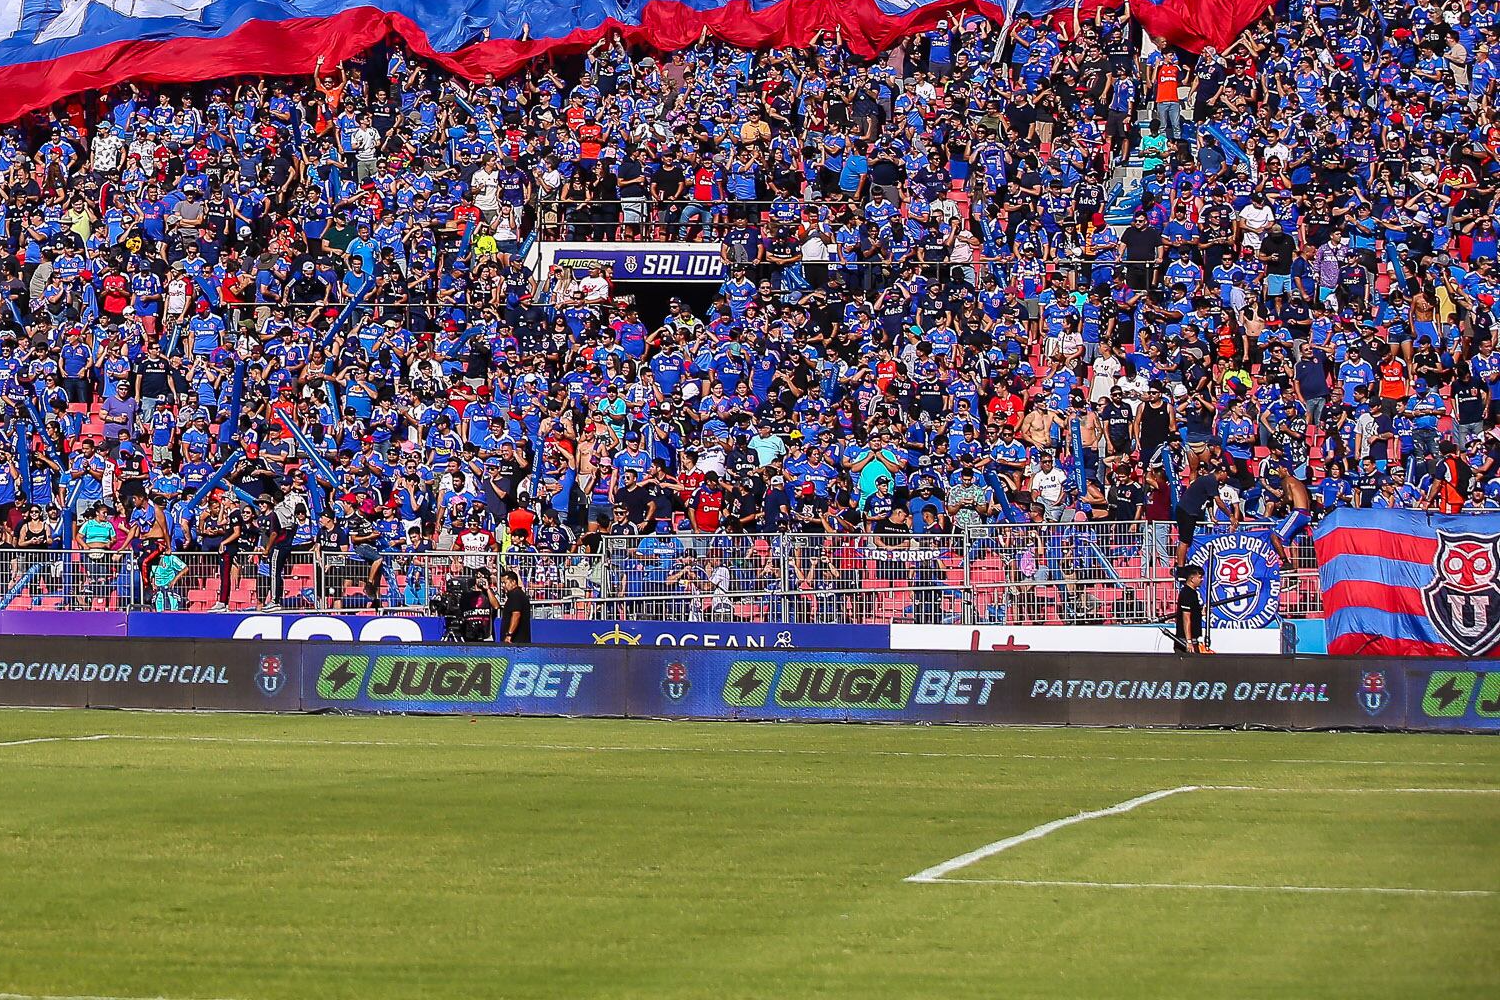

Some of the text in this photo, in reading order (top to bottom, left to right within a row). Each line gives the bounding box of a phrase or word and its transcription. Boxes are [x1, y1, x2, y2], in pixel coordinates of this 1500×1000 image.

[642, 254, 721, 275] SALIDA
[1240, 536, 1260, 553] POR
[865, 550, 887, 562] LOS
[1261, 598, 1279, 619] LOS
[1447, 595, 1489, 637] U
[139, 663, 229, 684] OFICIAL
[370, 661, 593, 699] JUGABET
[779, 668, 1005, 706] JUGABET
[1030, 680, 1330, 703] PATROCINADOR OFICIAL
